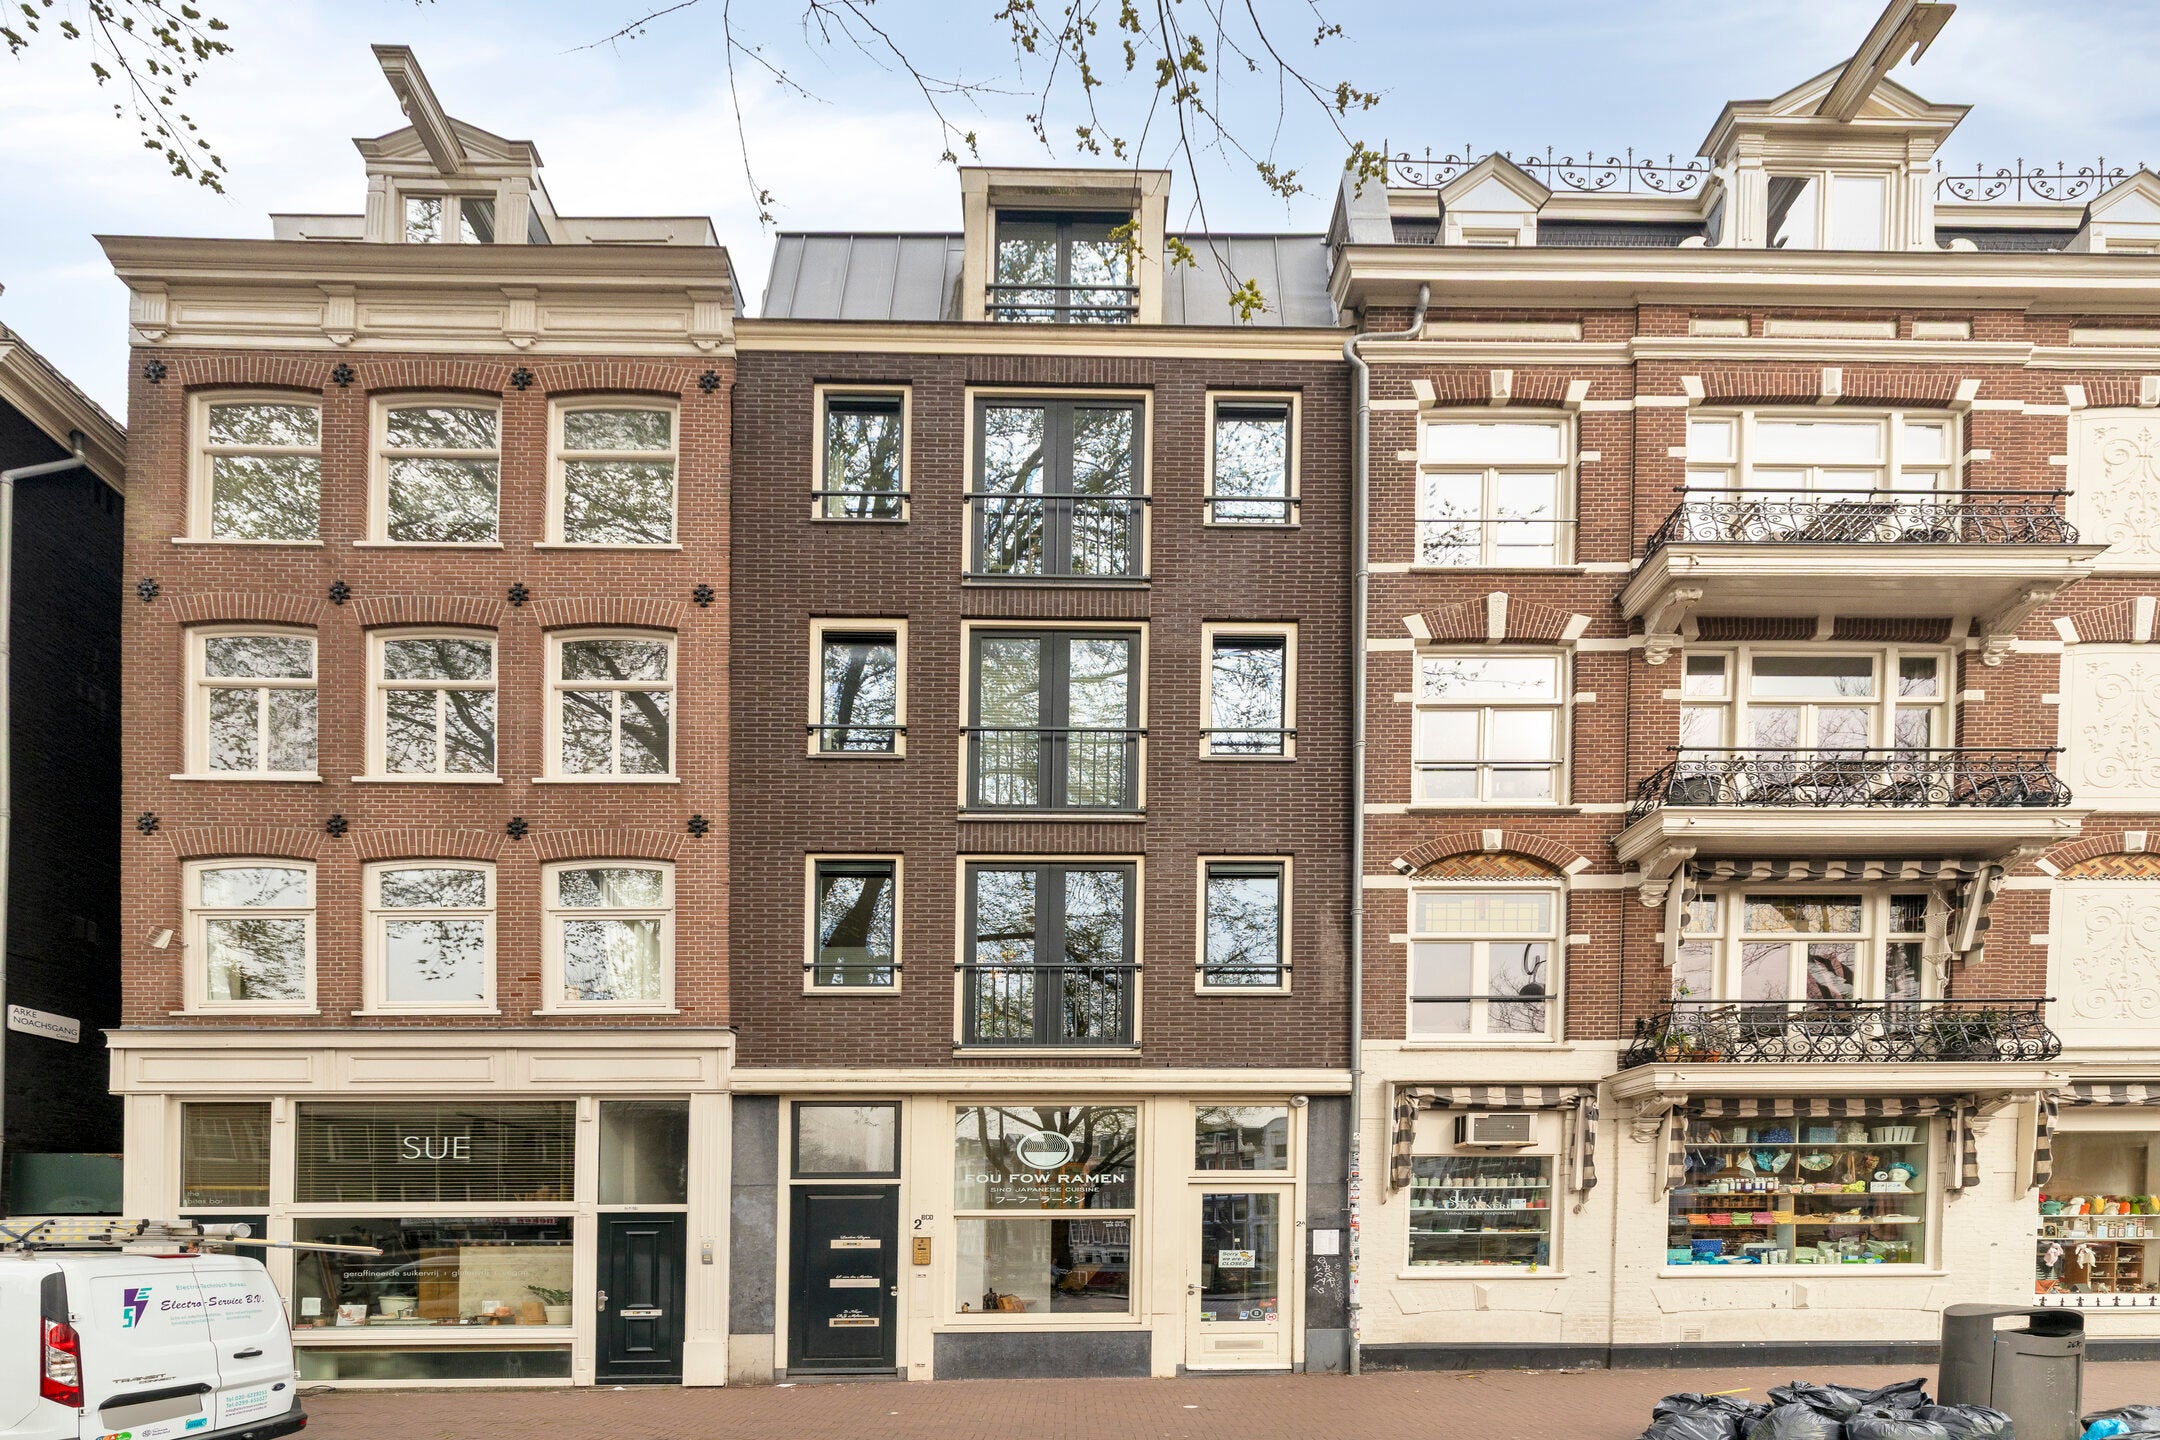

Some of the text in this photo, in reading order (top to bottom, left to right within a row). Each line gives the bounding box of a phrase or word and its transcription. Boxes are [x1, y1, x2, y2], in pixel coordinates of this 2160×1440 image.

[13, 1007, 38, 1018] ARKE
[13, 1016, 78, 1036] NOACHSGANG
[402, 1136, 471, 1159] SUE
[965, 1173, 1126, 1184] FOU FOW RAMEN
[994, 1196, 1086, 1204] フーフーラーメン
[914, 1218, 922, 1230] 2
[343, 1269, 400, 1278] geraffineerde
[402, 1269, 440, 1278] suikervrij
[245, 1294, 265, 1304] B.V.
